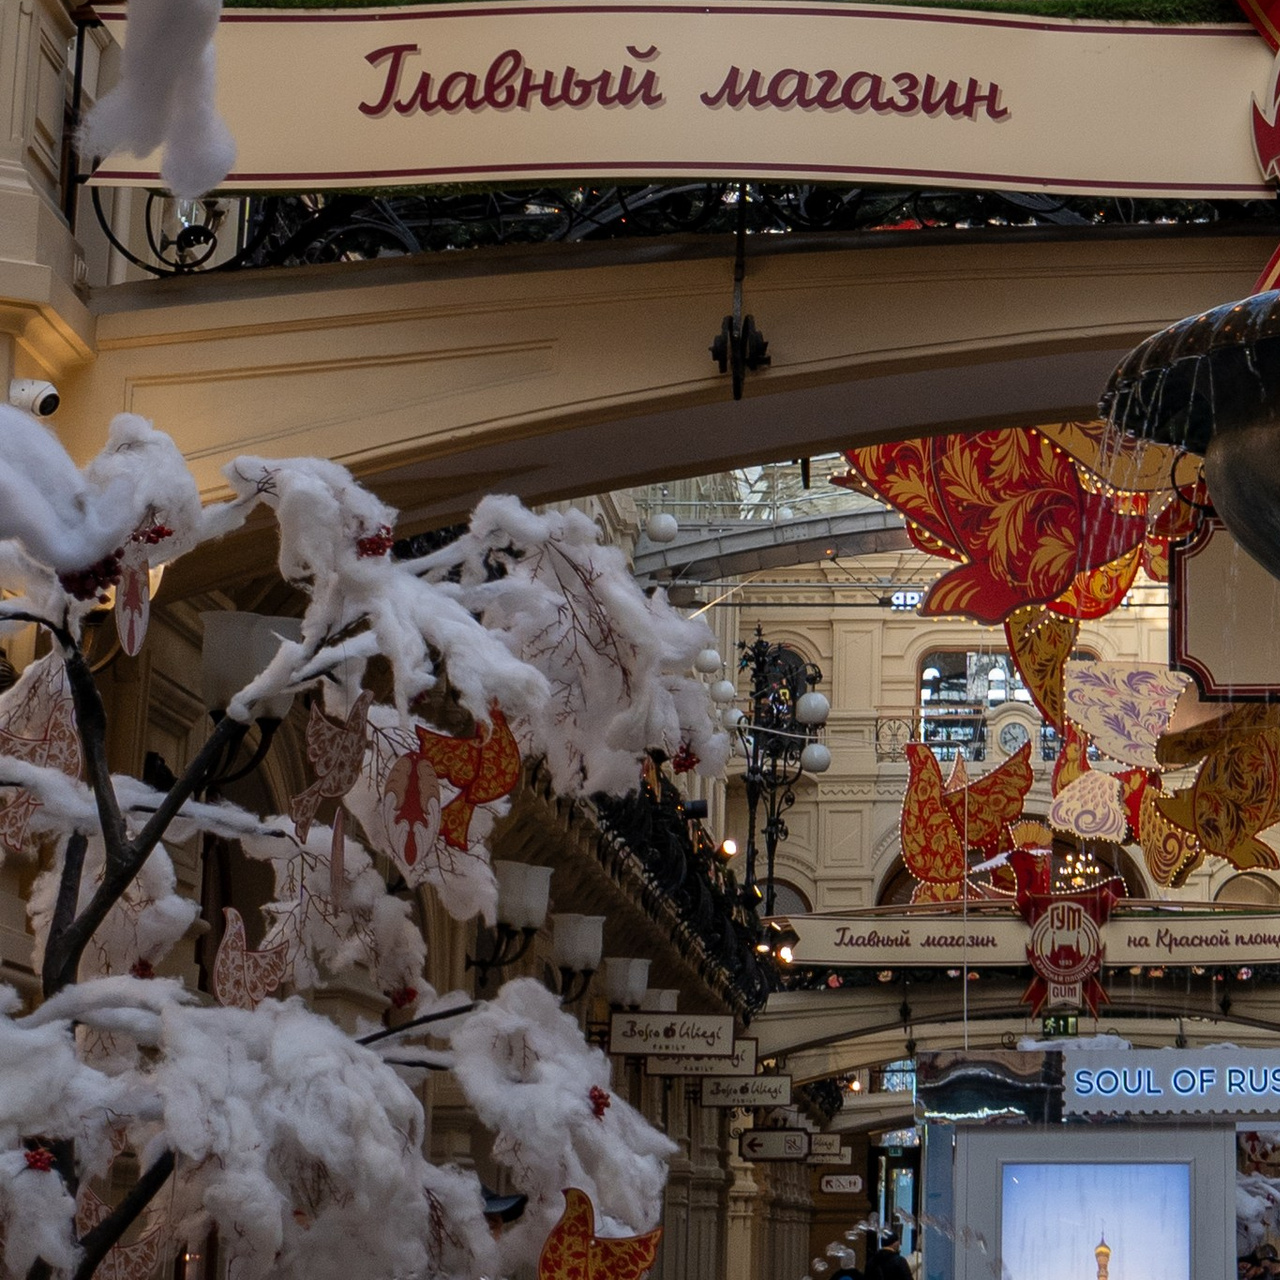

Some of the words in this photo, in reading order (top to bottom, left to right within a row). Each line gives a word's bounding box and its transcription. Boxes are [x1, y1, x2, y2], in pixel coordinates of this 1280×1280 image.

[358, 43, 663, 117] Главный
[700, 64, 1009, 121] магазин
[1050, 904, 1082, 931] ГУМ
[834, 926, 911, 947] Главный
[920, 934, 998, 947] магазин
[1127, 934, 1151, 948] на
[1155, 928, 1231, 954] Красной
[1051, 985, 1077, 999] GUM
[1075, 1068, 1161, 1095] SOUL
[1172, 1068, 1215, 1094] OF
